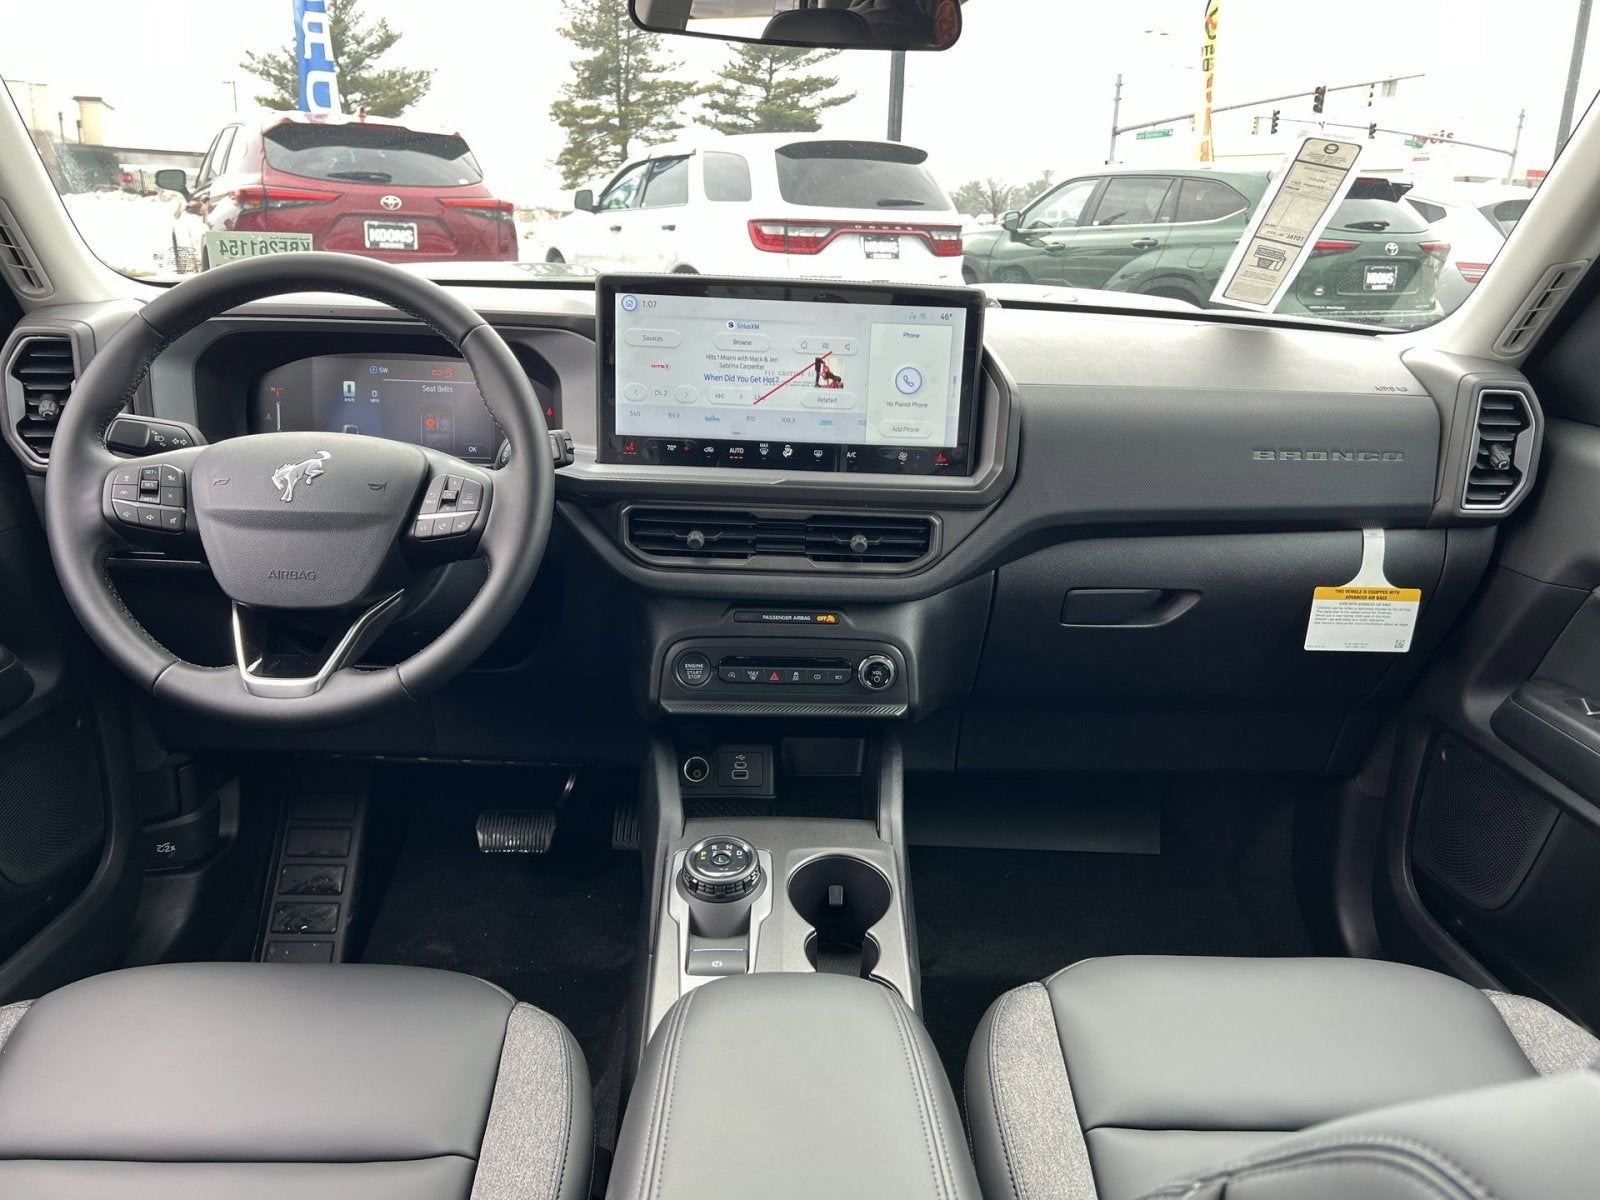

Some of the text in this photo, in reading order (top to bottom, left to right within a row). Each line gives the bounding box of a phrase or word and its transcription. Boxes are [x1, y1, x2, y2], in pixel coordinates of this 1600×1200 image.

[642, 300, 657, 308] 1:07
[642, 334, 663, 342] Sources
[903, 331, 920, 339] Phone
[740, 363, 765, 371] Carpenter
[704, 374, 723, 382] When
[422, 385, 436, 393] Seat
[1252, 449, 1405, 462] BRONCO
[268, 570, 316, 580] AIRBAG
